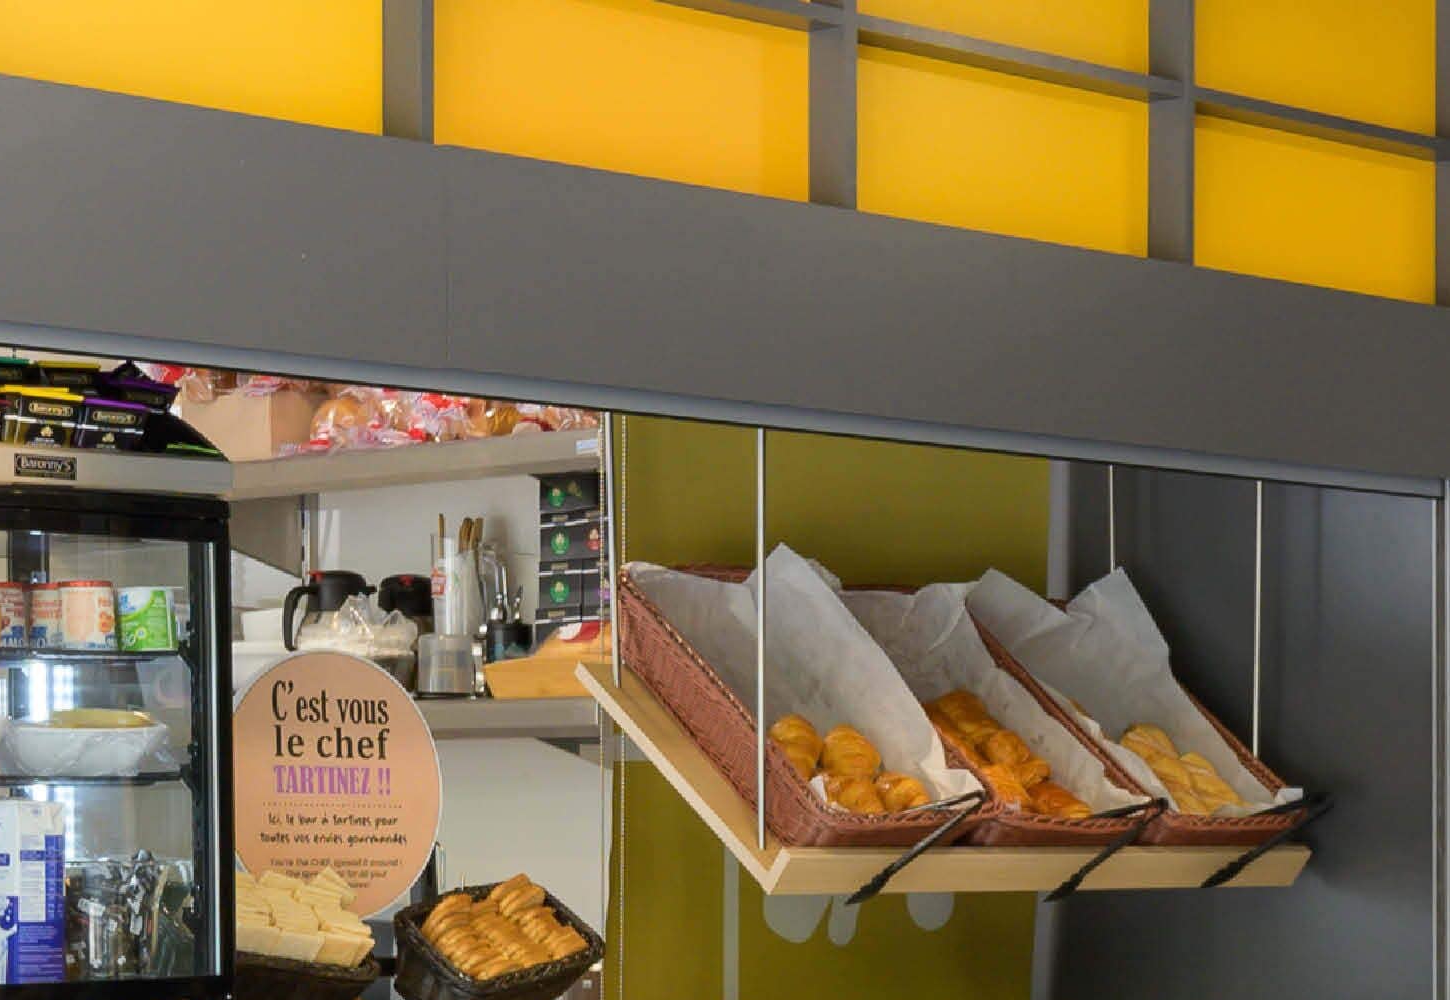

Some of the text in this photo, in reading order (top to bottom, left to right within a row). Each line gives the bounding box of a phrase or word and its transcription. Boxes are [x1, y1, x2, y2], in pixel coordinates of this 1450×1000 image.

[337, 698, 390, 725] vous
[274, 724, 390, 760] le chef
[273, 765, 391, 796] TARTINEZ !!
[286, 814, 294, 825] le
[298, 813, 317, 826] bar
[333, 814, 371, 827] tartines
[374, 816, 399, 831] pour
[260, 832, 290, 843] toutes
[293, 834, 310, 843] vos
[347, 834, 407, 847] gourmandes
